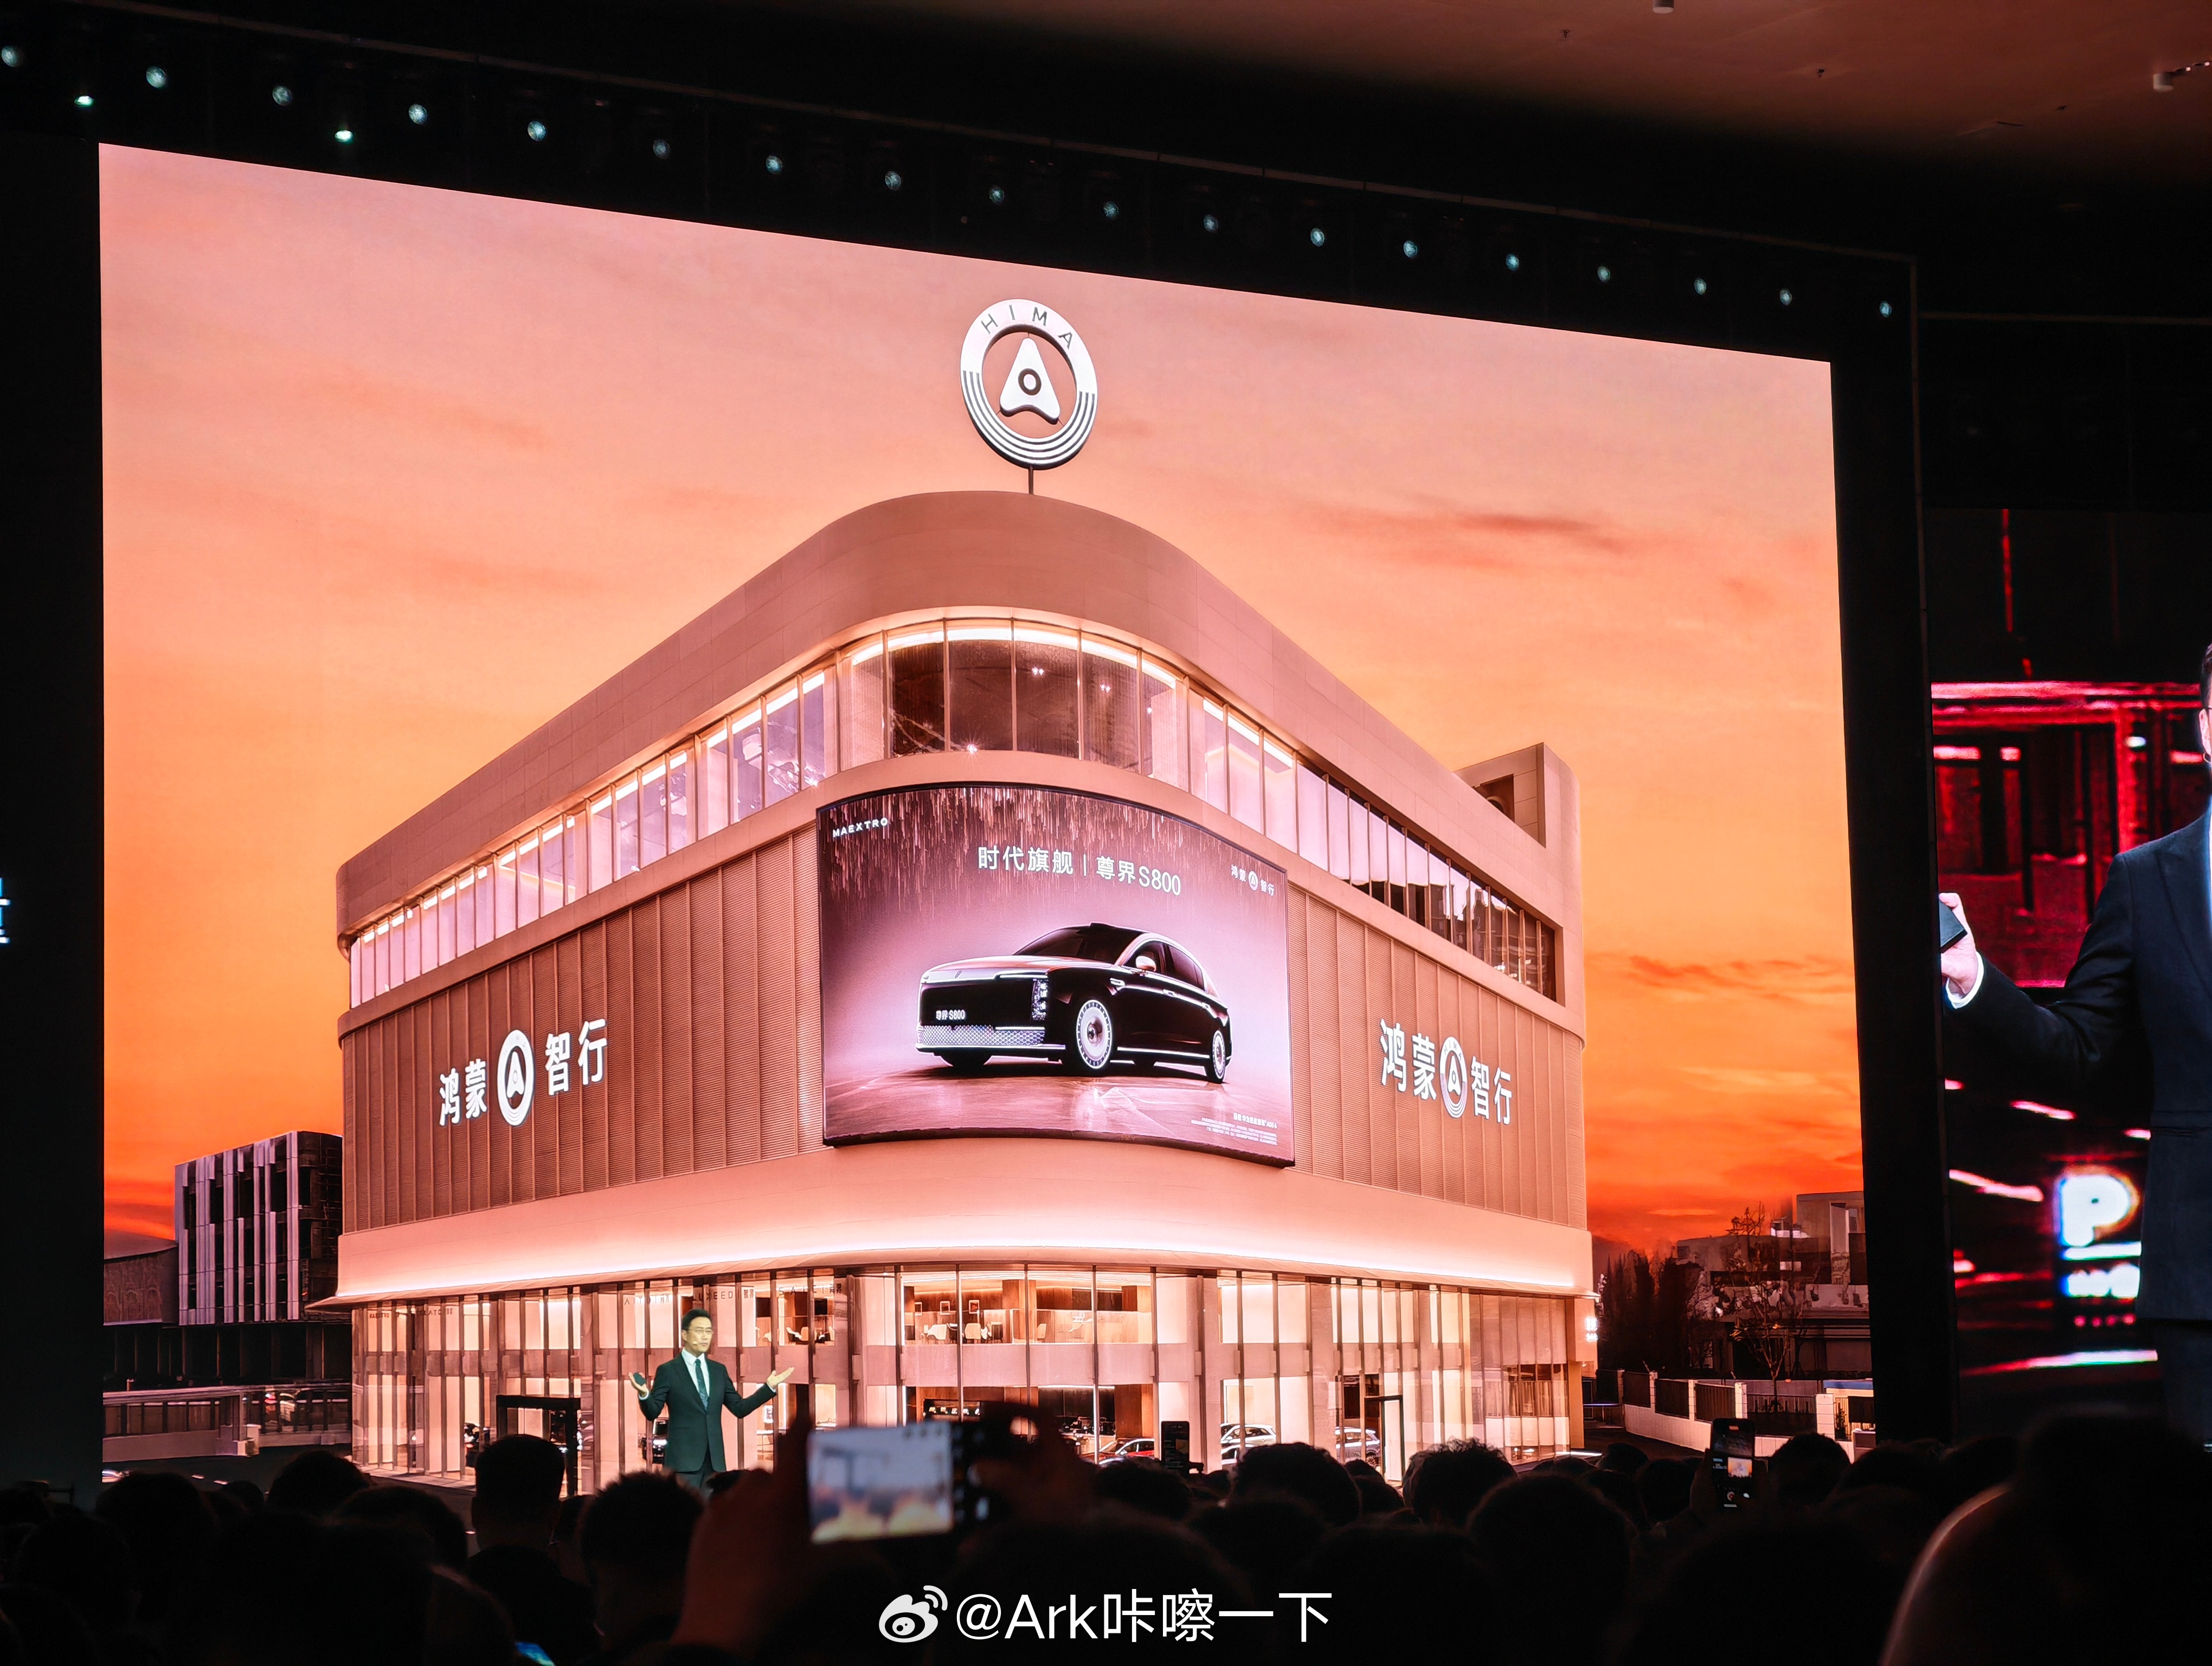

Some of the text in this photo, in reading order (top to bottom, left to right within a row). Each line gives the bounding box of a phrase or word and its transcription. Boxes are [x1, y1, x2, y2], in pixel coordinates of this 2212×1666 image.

[981, 304, 1073, 350] HIMA
[832, 817, 888, 838] MAEXTRO
[439, 1018, 608, 1126] 鸿蒙 智行
[1379, 1018, 1512, 1125] 鸿蒙 智行
